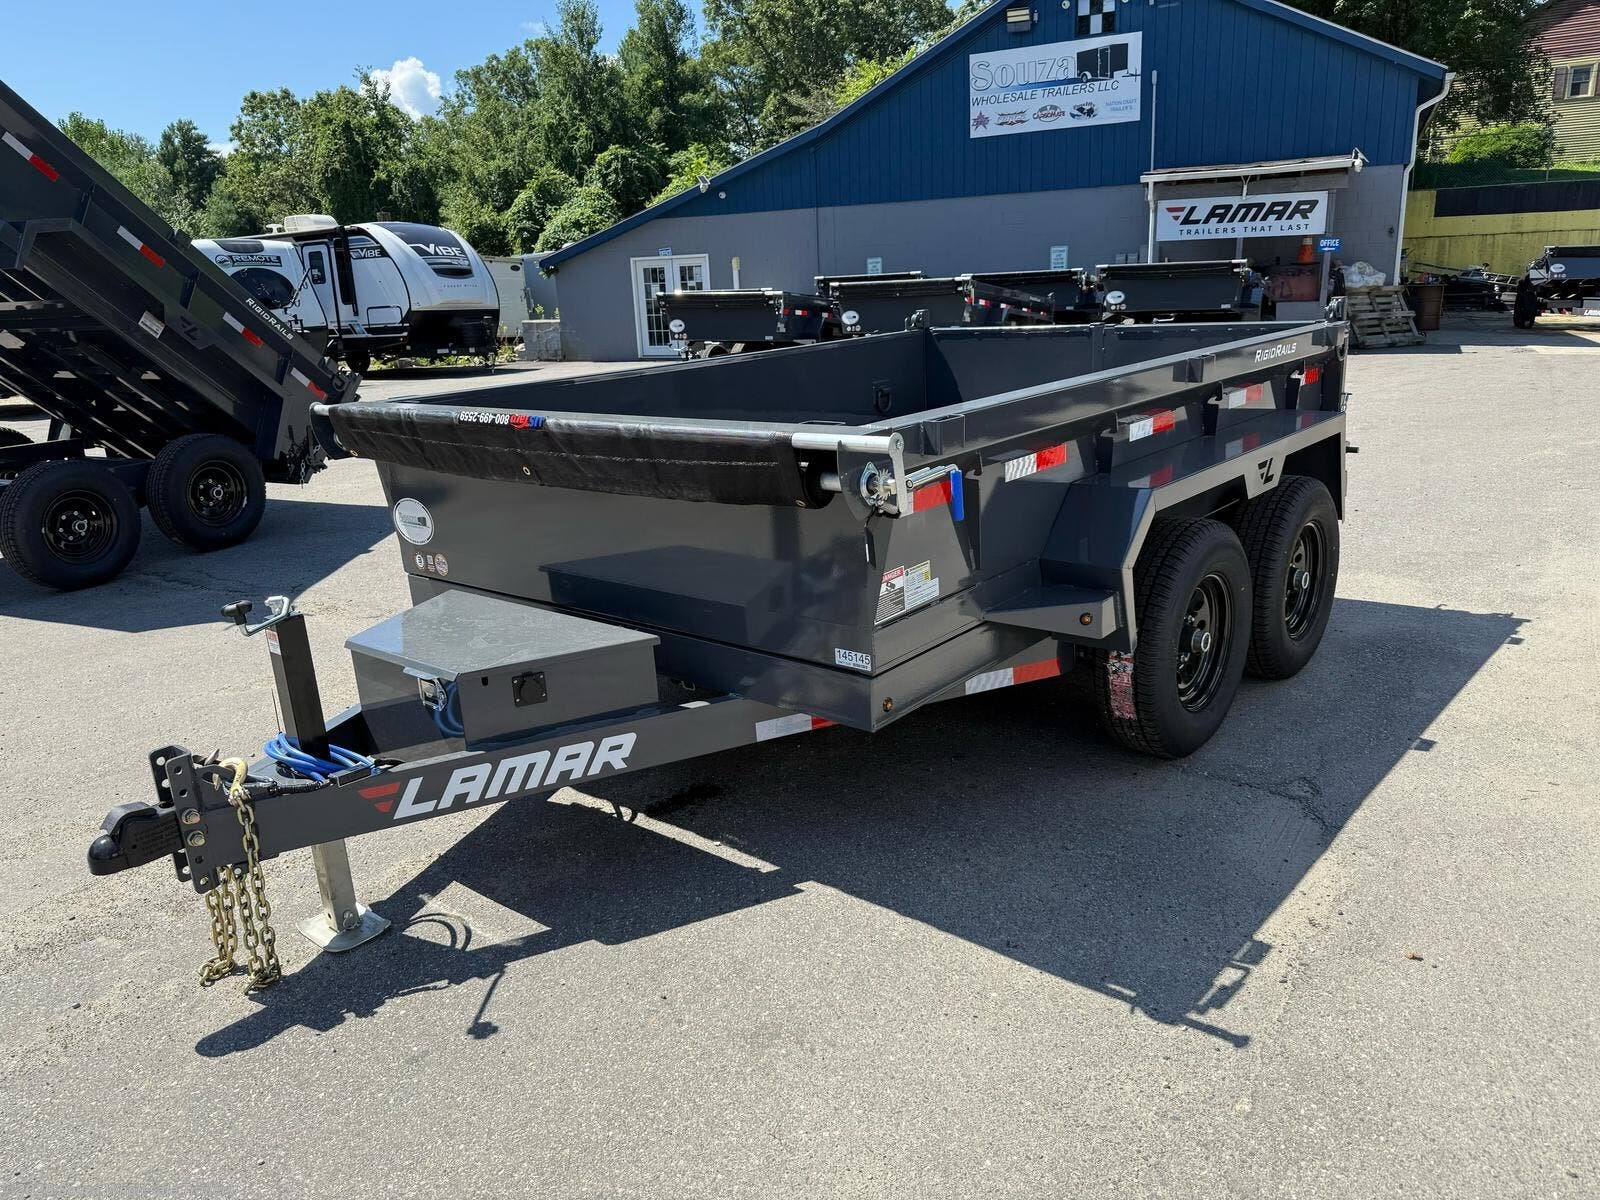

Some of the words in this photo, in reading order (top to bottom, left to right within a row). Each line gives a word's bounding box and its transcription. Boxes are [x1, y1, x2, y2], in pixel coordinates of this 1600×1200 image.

[970, 55, 1077, 91] Souza
[971, 91, 1037, 107] WHOLESALE
[1041, 83, 1095, 99] TRAILERS
[1098, 80, 1120, 92] LLC
[1180, 199, 1320, 226] LAMAR
[1179, 227, 1237, 236] TRAILERS
[1244, 225, 1273, 233] THAT
[1280, 223, 1311, 231] LAST
[1320, 238, 1340, 247] OFFICE
[460, 411, 510, 425] 800-499-2559
[837, 650, 870, 665] 145145
[394, 732, 637, 819] LAMAR
